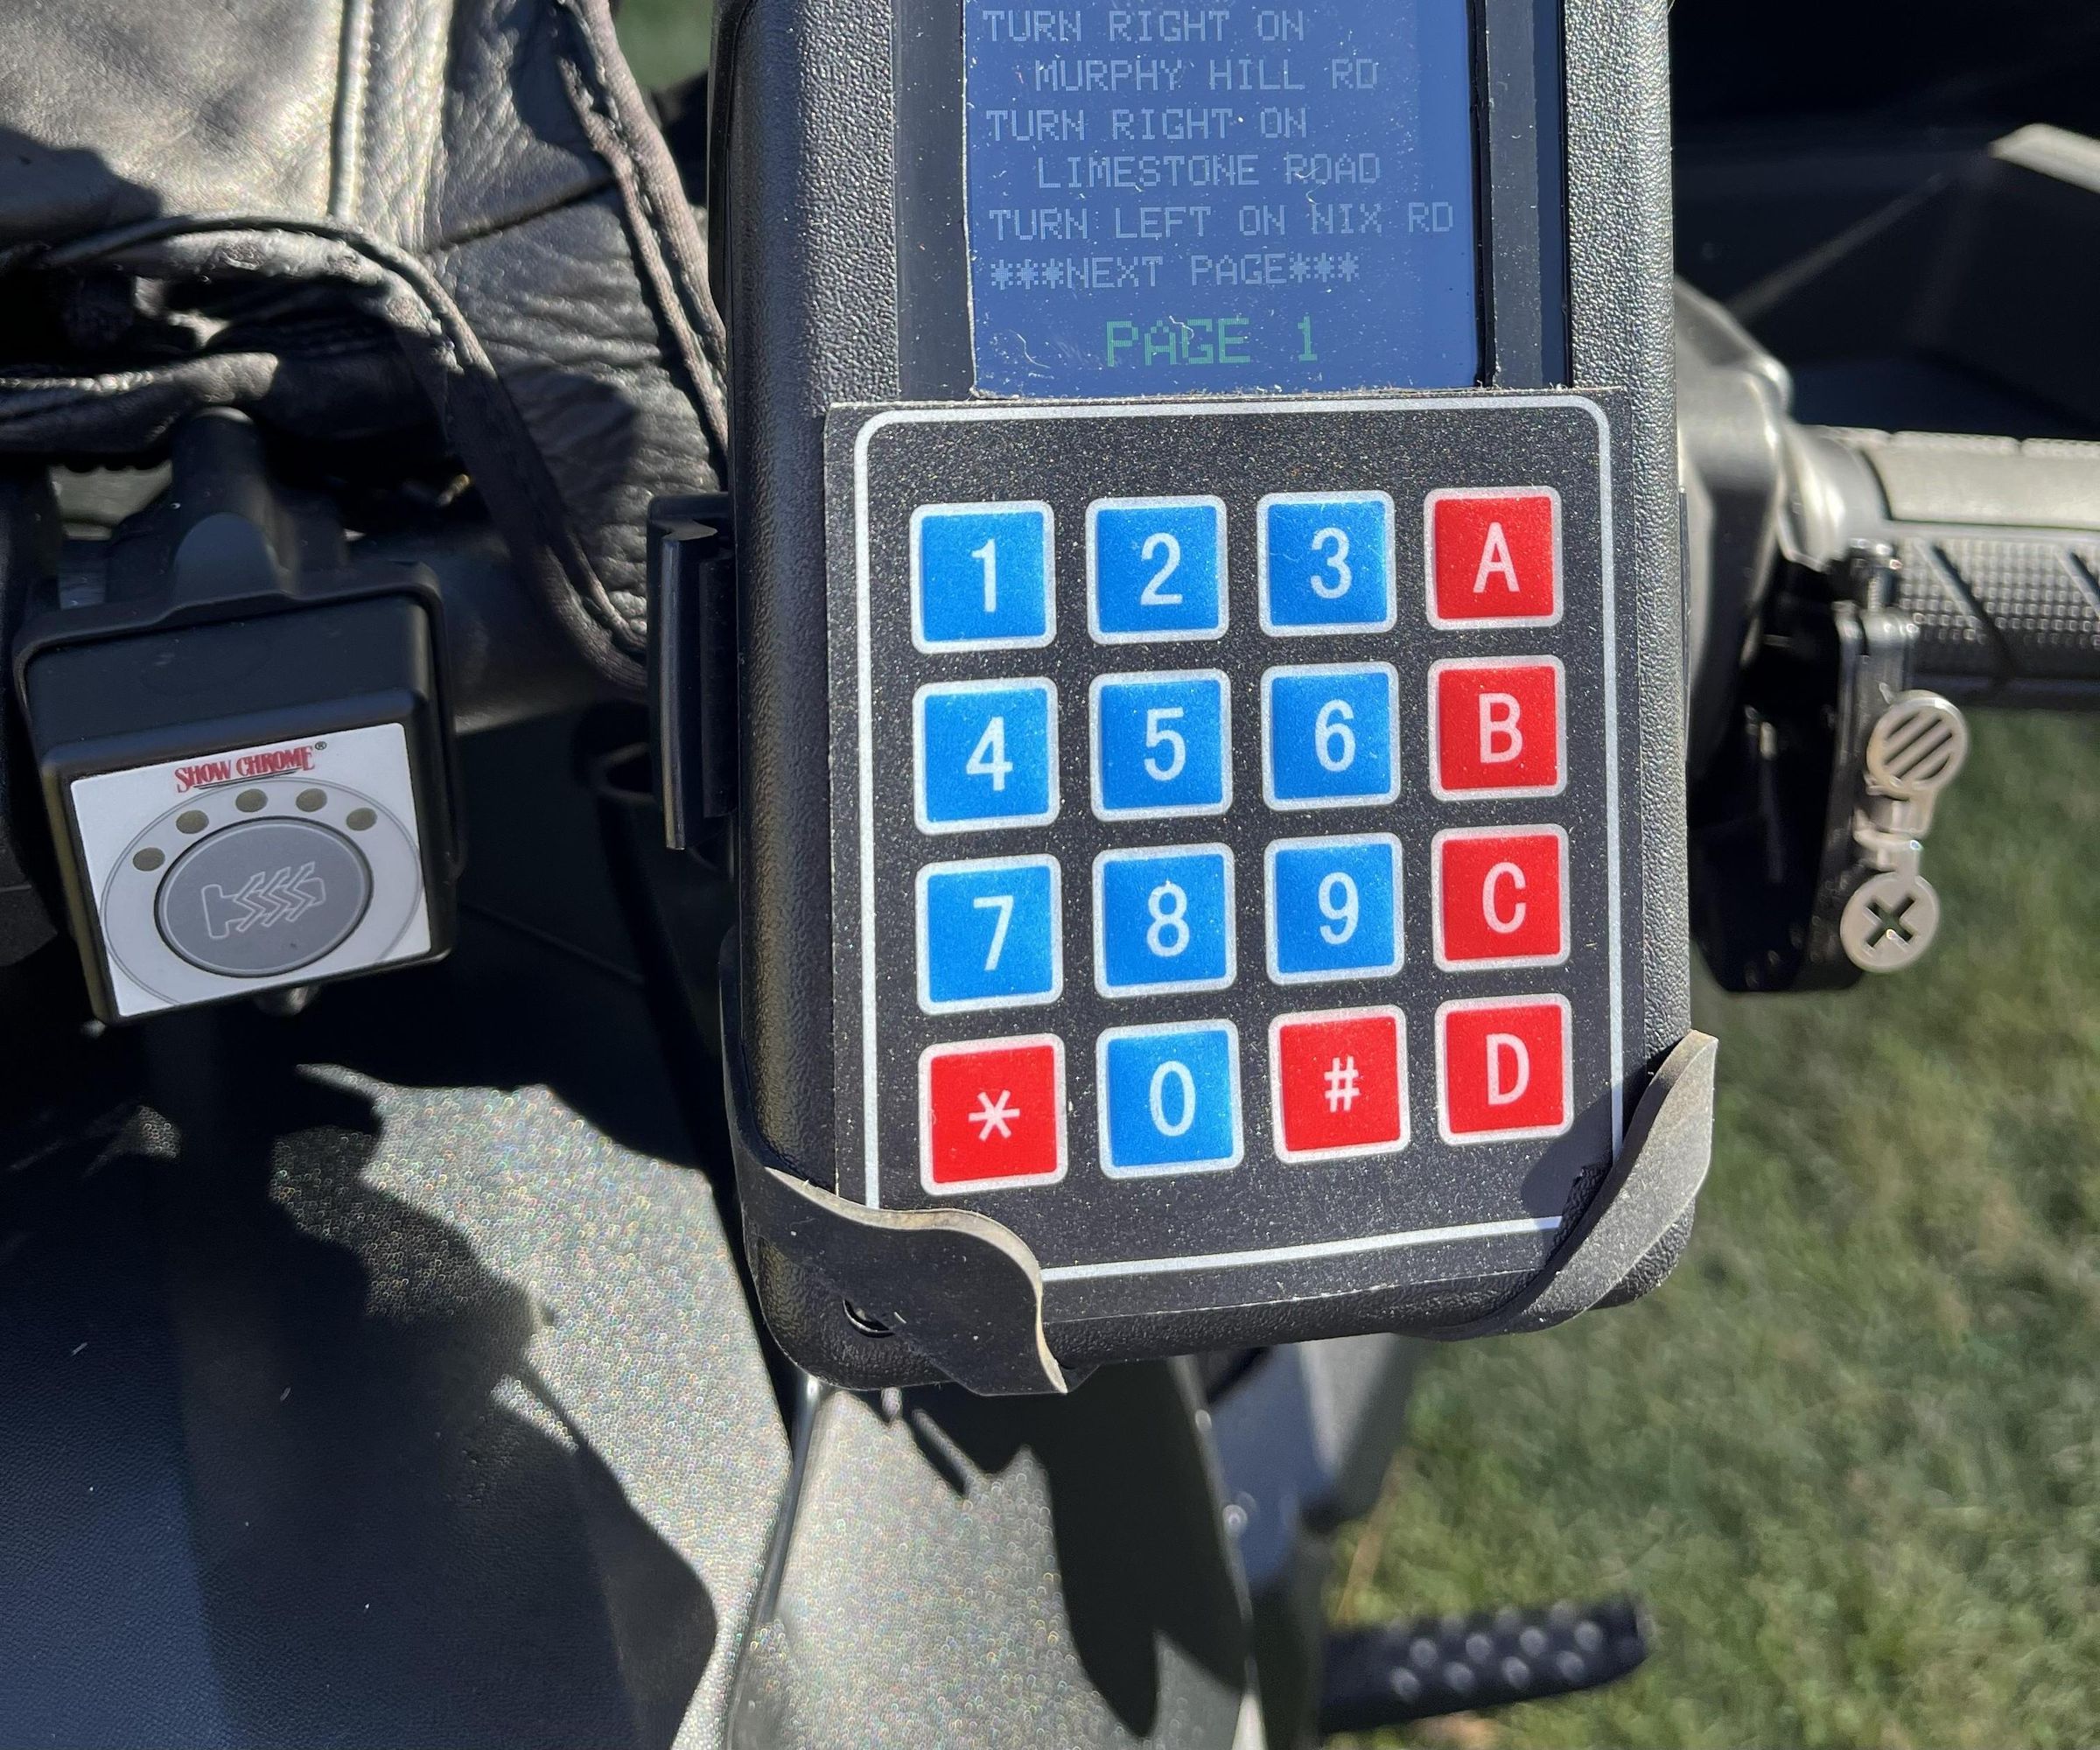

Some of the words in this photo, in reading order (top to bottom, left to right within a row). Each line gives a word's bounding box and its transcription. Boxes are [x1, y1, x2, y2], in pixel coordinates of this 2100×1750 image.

[983, 10, 1082, 42] TURN
[1109, 10, 1230, 42] RIGHT
[1256, 10, 1304, 41] ON
[1035, 60, 1183, 91] MURPHY
[1209, 59, 1306, 90] HILL
[1332, 58, 1378, 89] RD
[986, 108, 1085, 142] TURN
[1112, 108, 1233, 140] RIGHT
[1260, 107, 1307, 138] ON
[1038, 154, 1259, 189] LIMESTONE
[1285, 152, 1381, 184] ROAD
[989, 208, 1088, 241] TURN
[1115, 206, 1211, 238] LEFT
[1239, 205, 1284, 236] ON
[1312, 203, 1382, 234] NIX
[1407, 201, 1453, 233] RD
[1106, 317, 1250, 367] PAGE
[1298, 317, 1318, 362] 1
[971, 539, 998, 612] 1
[1140, 532, 1183, 606] 2
[1310, 527, 1353, 599] 3
[1473, 522, 1520, 593] A
[965, 716, 1013, 792] 4
[1144, 707, 1186, 781] 5
[1314, 698, 1356, 773] 6
[1479, 692, 1523, 764] B
[174, 760, 231, 793] SHOW
[235, 746, 315, 777] CHROME
[972, 895, 1015, 971] 7
[1146, 881, 1191, 958] 8
[1318, 872, 1360, 945] 9
[1482, 861, 1527, 934] C
[1149, 1060, 1197, 1138] 0
[1324, 1055, 1361, 1113] #
[1486, 1032, 1530, 1105] D
